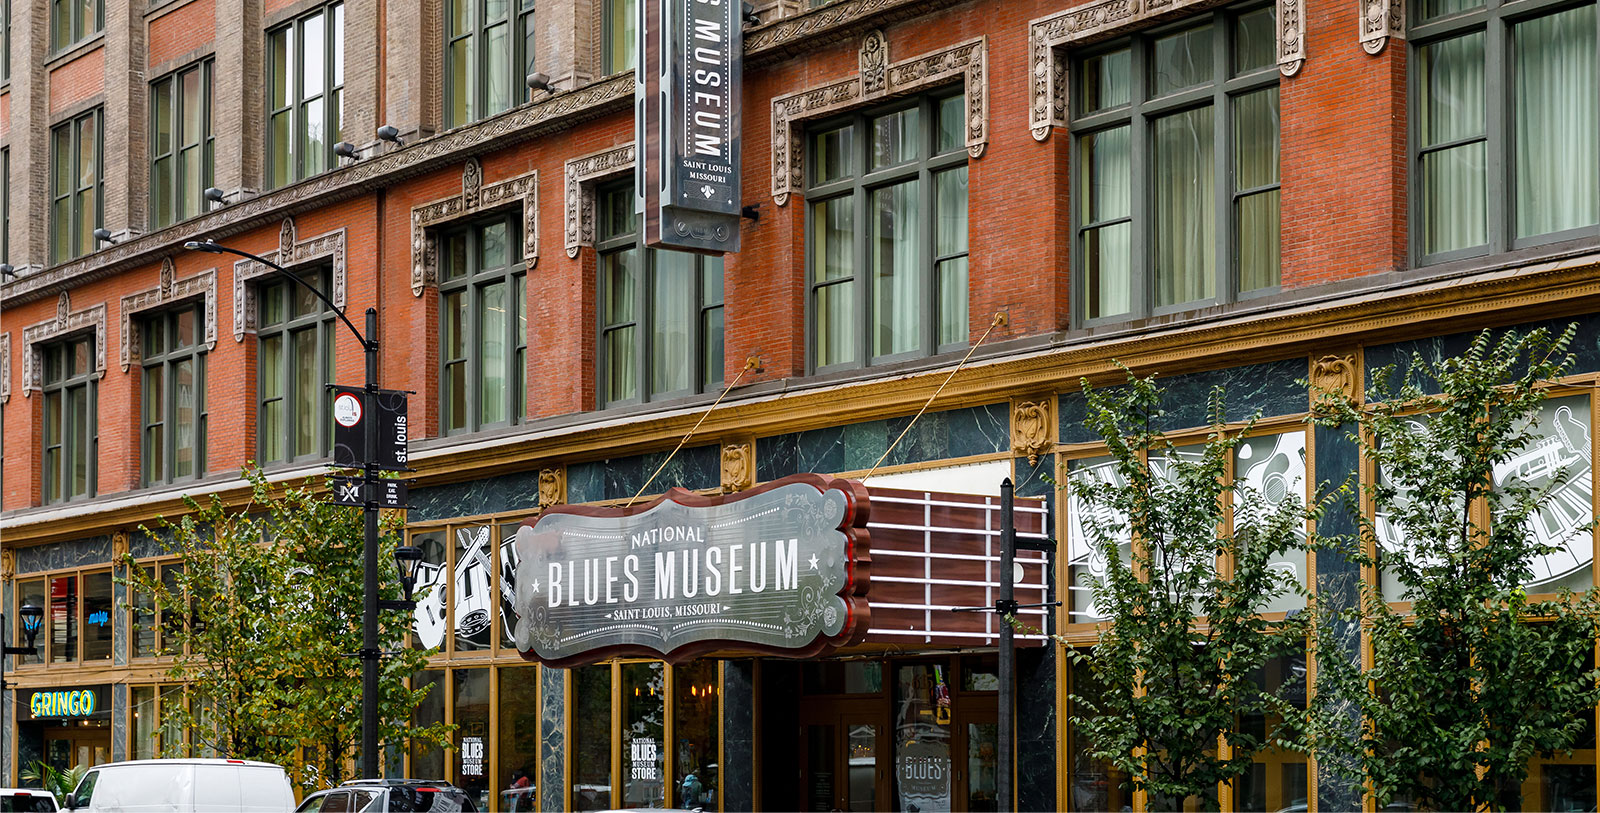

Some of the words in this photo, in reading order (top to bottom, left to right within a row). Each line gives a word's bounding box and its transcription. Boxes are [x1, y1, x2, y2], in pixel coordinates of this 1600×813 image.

[694, 19, 721, 157] MUSEUM
[683, 160, 707, 170] SAINT
[708, 164, 732, 174] LOUIS
[689, 171, 726, 184] MISSOURI
[394, 415, 407, 445] louis
[394, 447, 407, 463] st.
[631, 526, 704, 549] NATIONAL
[548, 554, 639, 608] BLUES
[654, 538, 798, 600] MUSEUM
[613, 608, 640, 621] SAINT
[642, 606, 673, 619] LOUIS,
[675, 602, 721, 617] MISSOURI
[30, 689, 96, 717] GRINGO
[462, 742, 483, 759] BLUES
[631, 744, 657, 761] BLUES
[462, 764, 483, 776] STORE
[631, 767, 657, 780] STORE
[905, 756, 942, 780] BLUES
